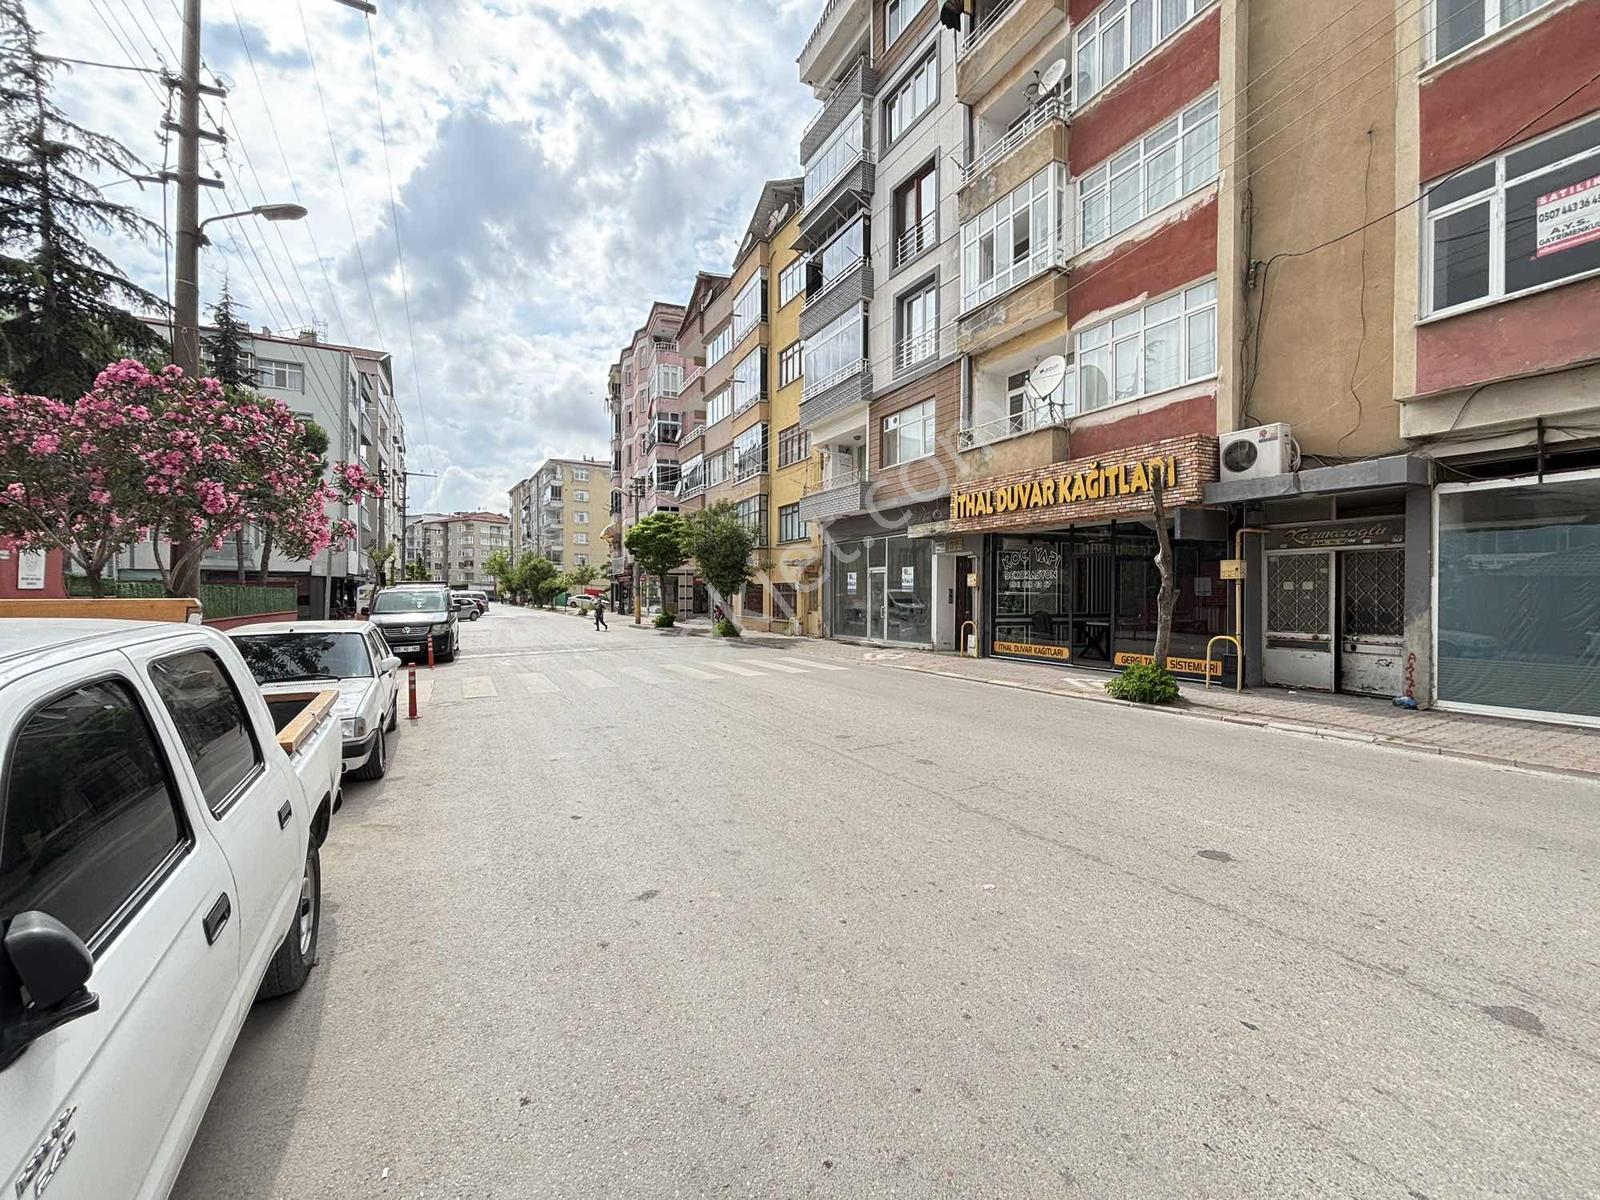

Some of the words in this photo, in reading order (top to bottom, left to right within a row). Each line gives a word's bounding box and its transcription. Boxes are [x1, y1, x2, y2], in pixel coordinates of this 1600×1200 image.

[1540, 175, 1600, 206] SATILIK
[1538, 208, 1560, 223] 0507
[1562, 201, 1577, 214] 443
[1579, 198, 1590, 210] 36
[996, 479, 1055, 513] DUVAR
[1014, 644, 1032, 654] DUVAR
[1170, 659, 1218, 674] SİSTEMLERİ
